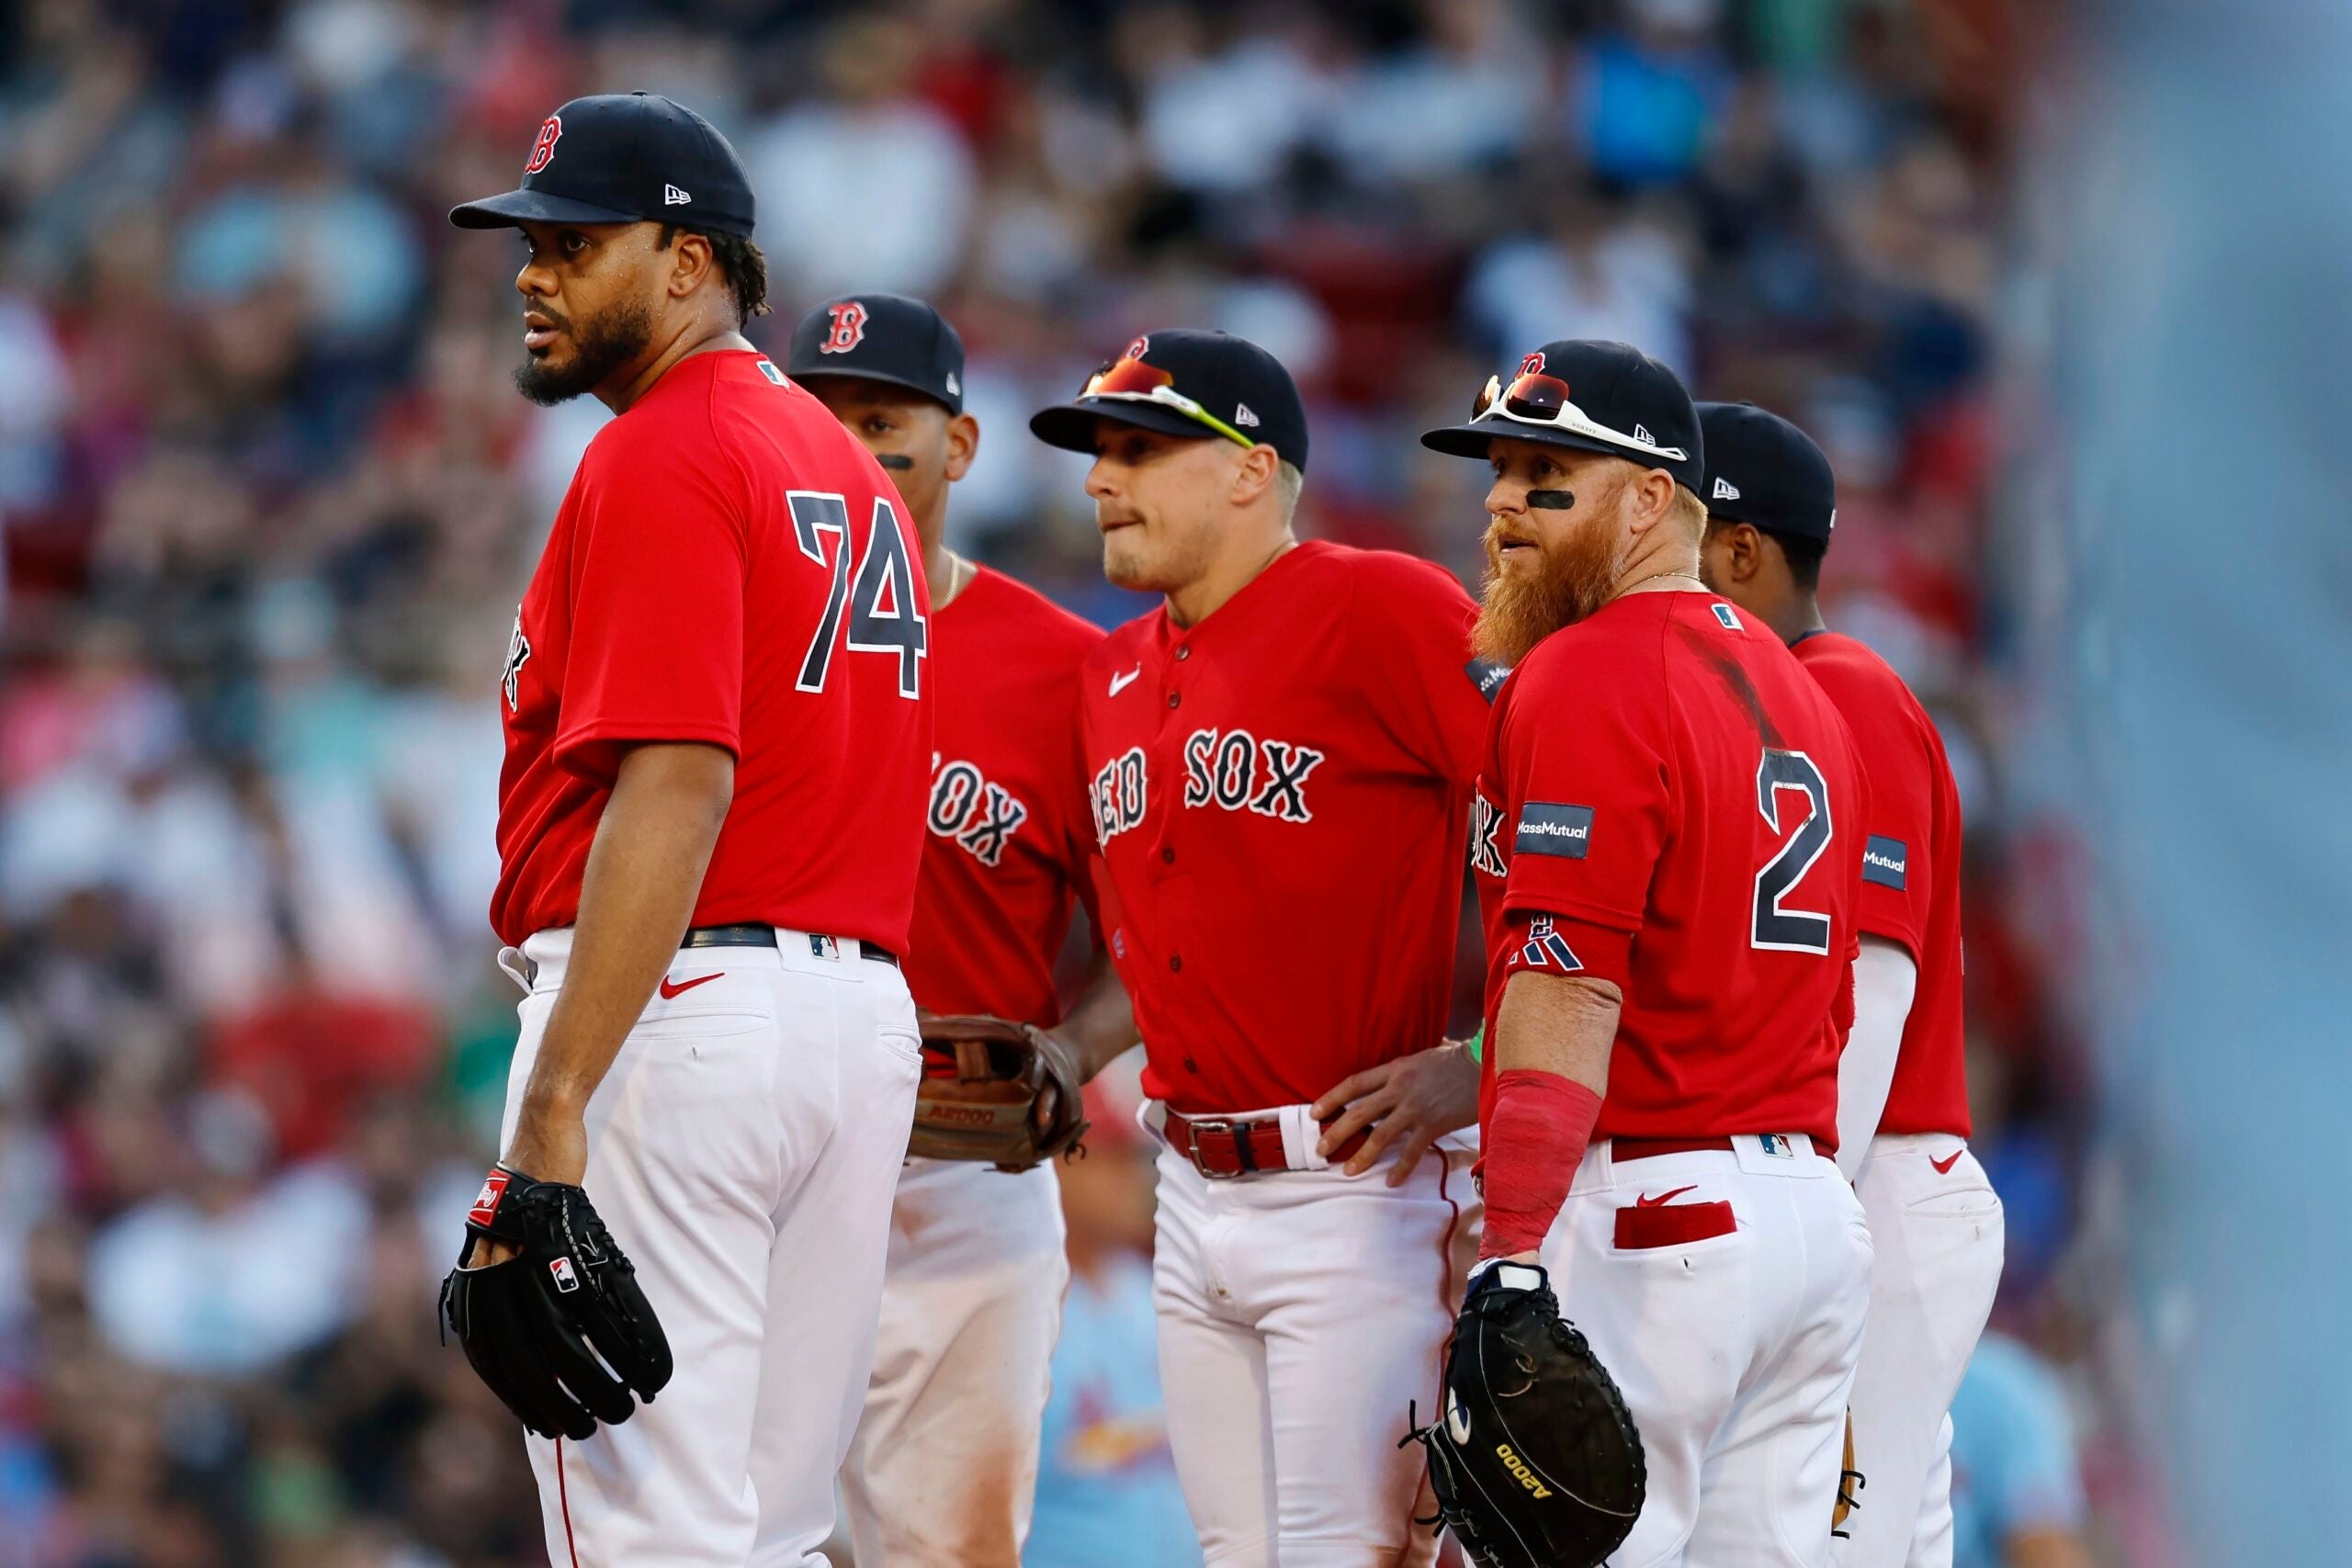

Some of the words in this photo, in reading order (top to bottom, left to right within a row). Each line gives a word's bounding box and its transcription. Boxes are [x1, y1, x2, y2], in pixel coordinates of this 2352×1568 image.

[526, 116, 562, 175] B
[820, 301, 869, 354] B
[786, 491, 927, 700] 74
[927, 750, 1027, 867] OX
[1183, 727, 1325, 824] SOX
[1751, 747, 1833, 955] 2
[1496, 1443, 1553, 1500] A2000
